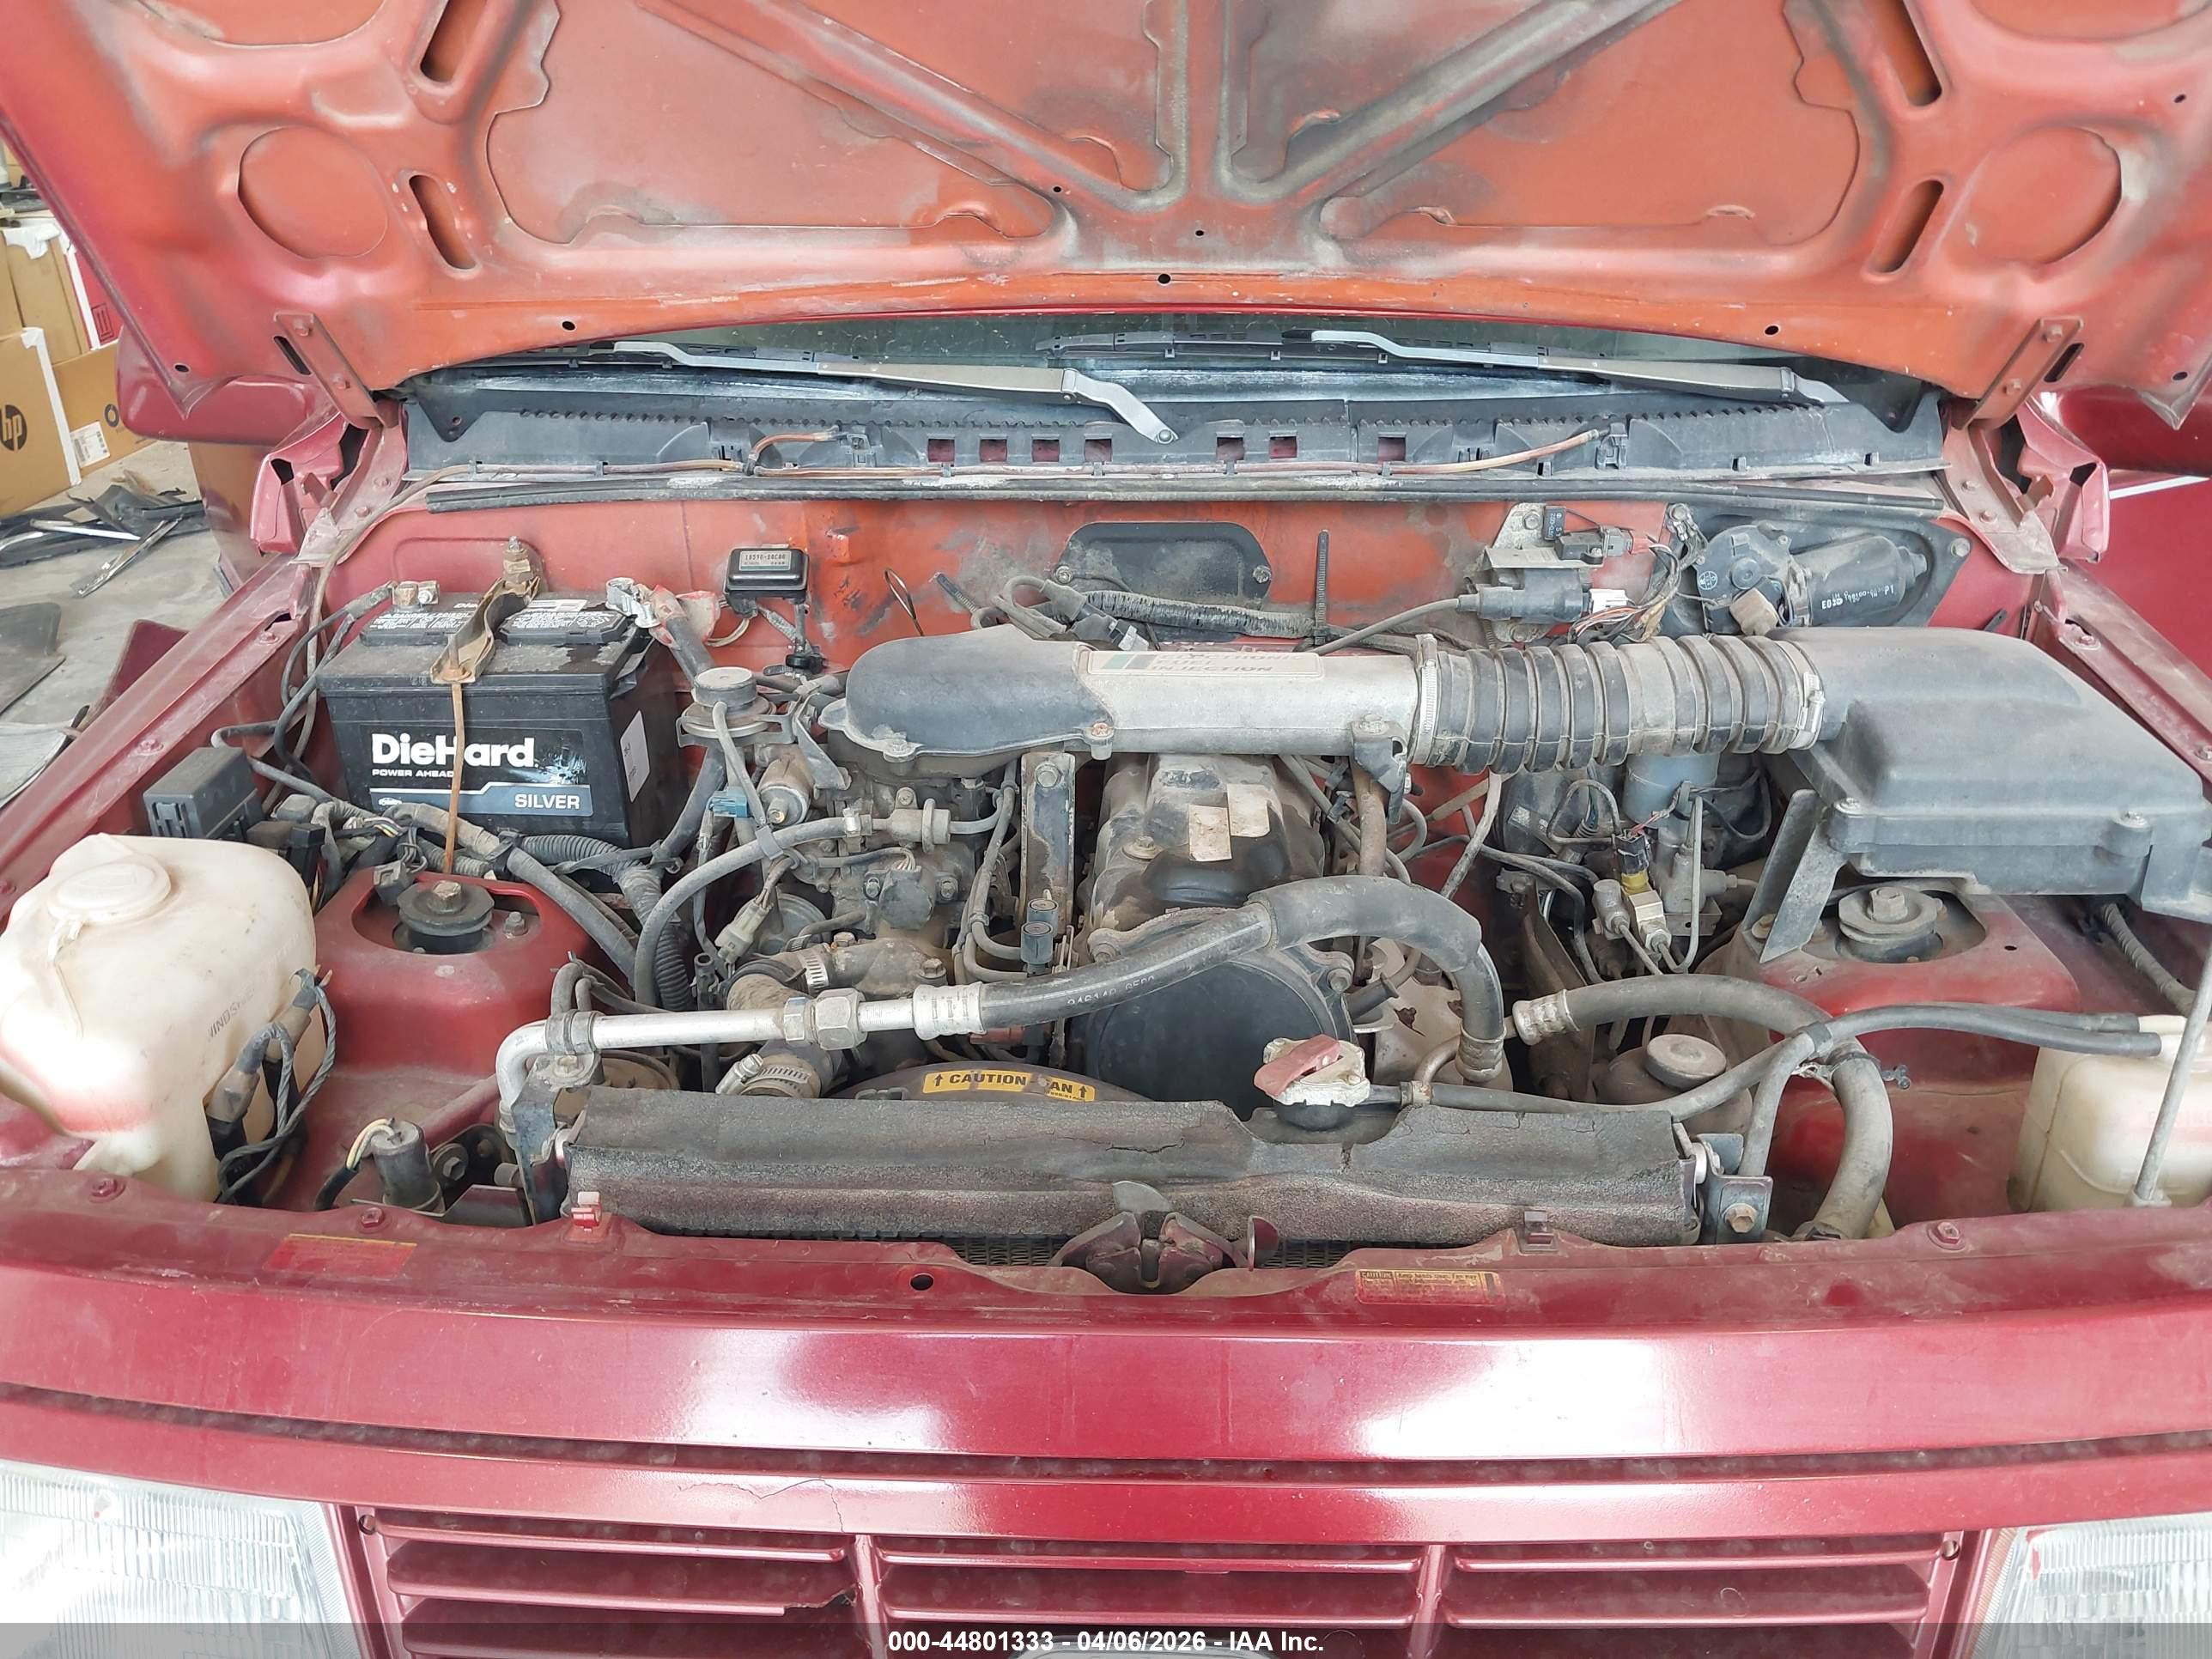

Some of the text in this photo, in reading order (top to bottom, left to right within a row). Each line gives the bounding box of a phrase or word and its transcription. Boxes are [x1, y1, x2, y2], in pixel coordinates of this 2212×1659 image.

[1, 404, 24, 452] hp
[416, 769, 454, 778] AHEAD
[514, 793, 580, 810] SILVER
[949, 1073, 1073, 1094] CAUTION AN
